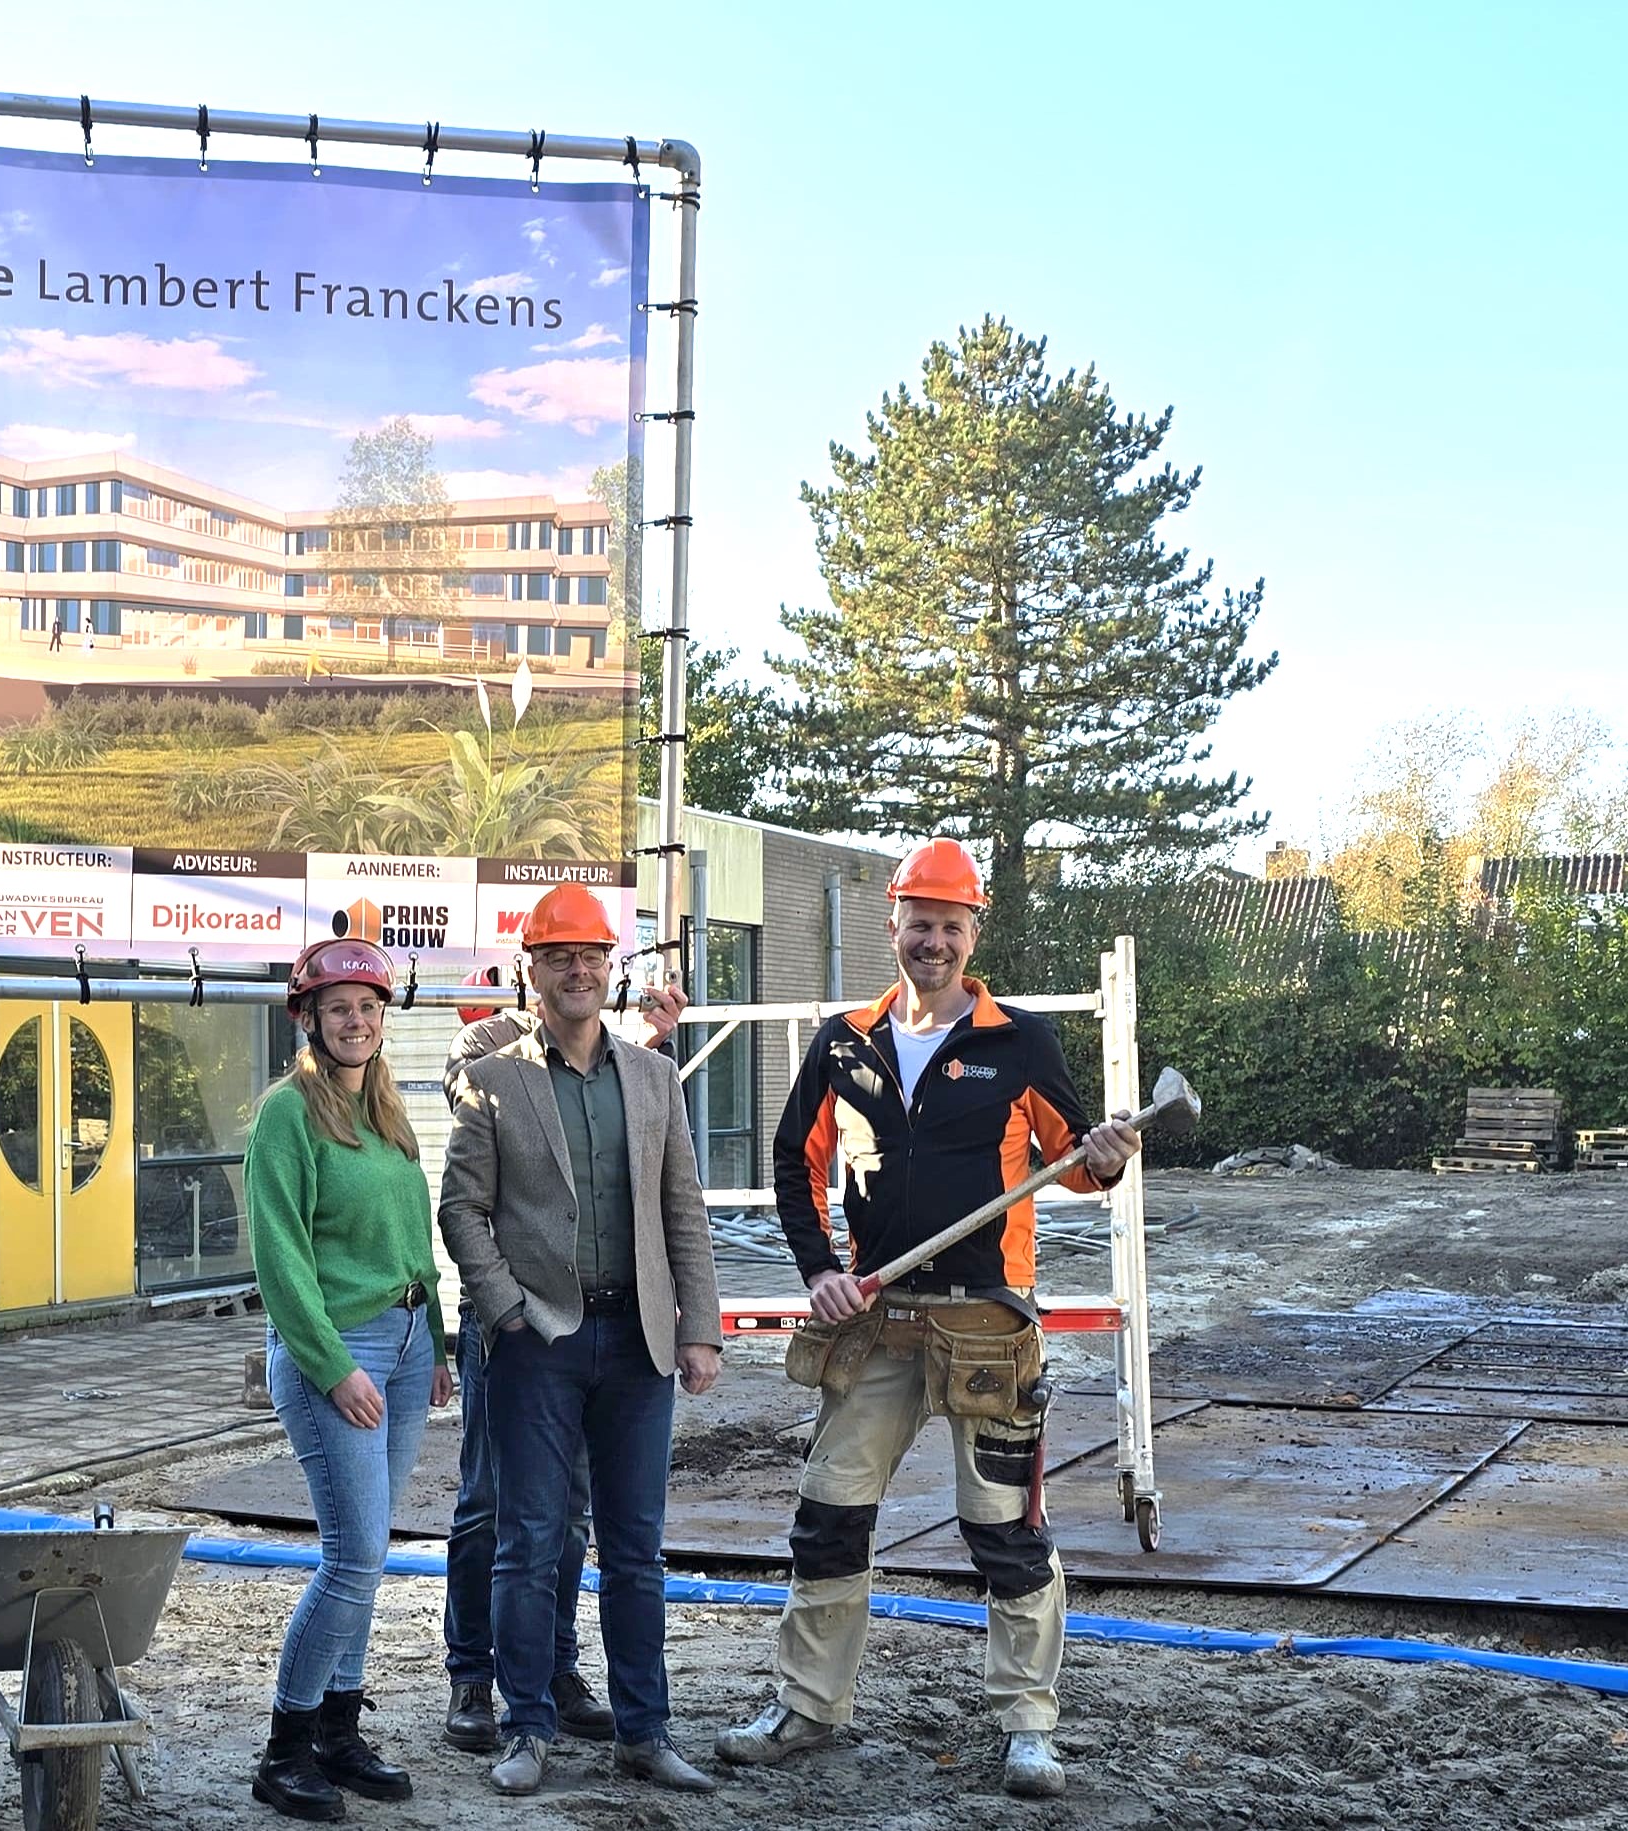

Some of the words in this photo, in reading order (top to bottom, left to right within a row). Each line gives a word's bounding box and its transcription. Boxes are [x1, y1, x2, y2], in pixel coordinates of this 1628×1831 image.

[37, 258, 270, 312] Lambert
[294, 271, 564, 330] Franckens
[173, 855, 258, 872] ADVISEUR:
[346, 861, 441, 878] AANNEMER:
[504, 864, 614, 882] INSTALLATEUR:
[20, 910, 103, 937] VEN
[152, 904, 282, 935] Dijkoraad
[382, 905, 449, 926] PRINS
[382, 927, 447, 948] BOUW
[342, 960, 373, 972] KASK
